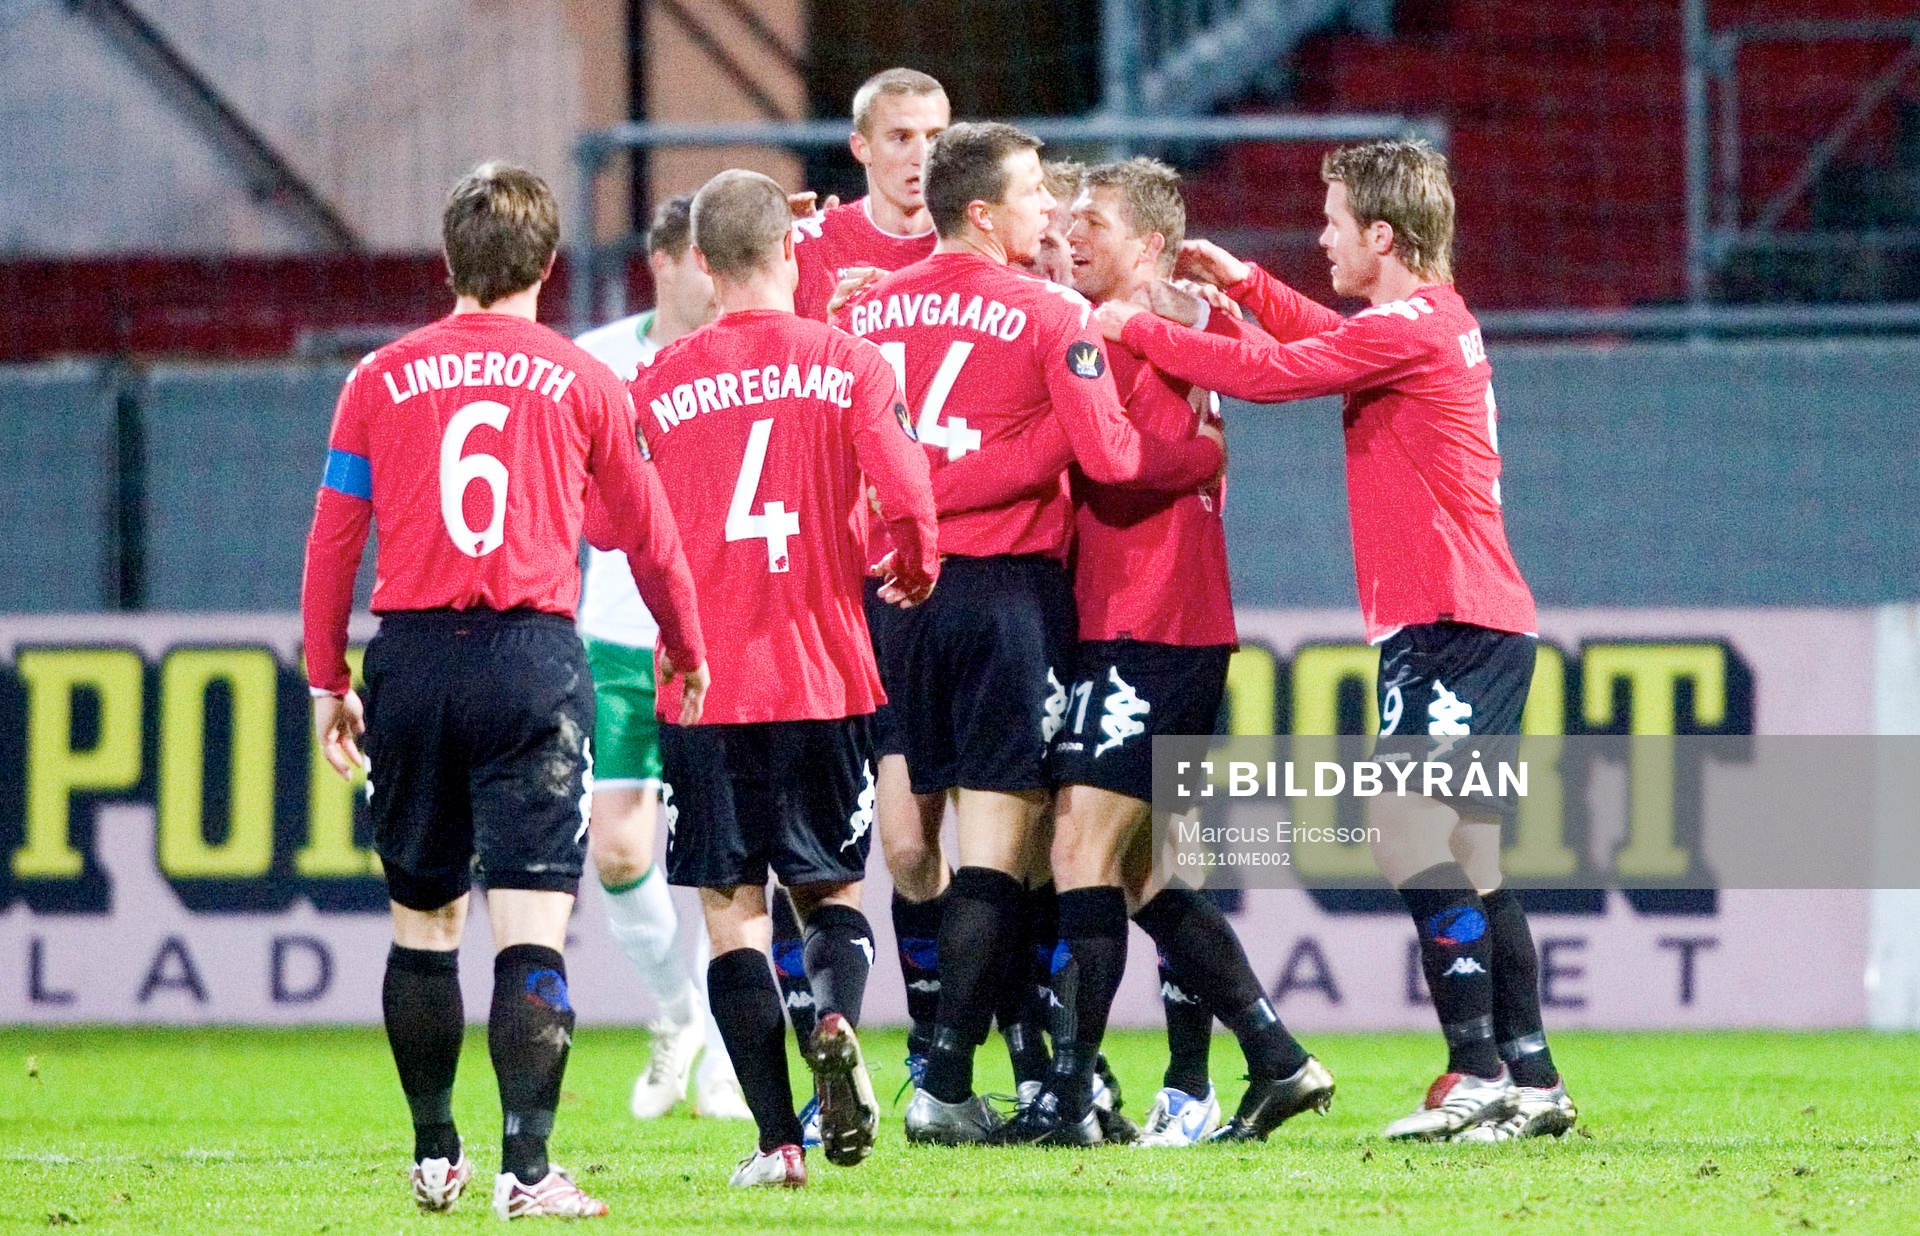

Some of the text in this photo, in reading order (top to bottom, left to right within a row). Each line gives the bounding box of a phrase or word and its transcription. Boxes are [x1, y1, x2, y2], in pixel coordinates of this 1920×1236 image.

[852, 292, 1026, 341] GRAVGAARD
[383, 351, 576, 404] LINDEROTH
[650, 363, 855, 433] NØRREGAARD
[439, 400, 510, 558] 6
[725, 418, 800, 573] 4
[1064, 681, 1094, 734] 1
